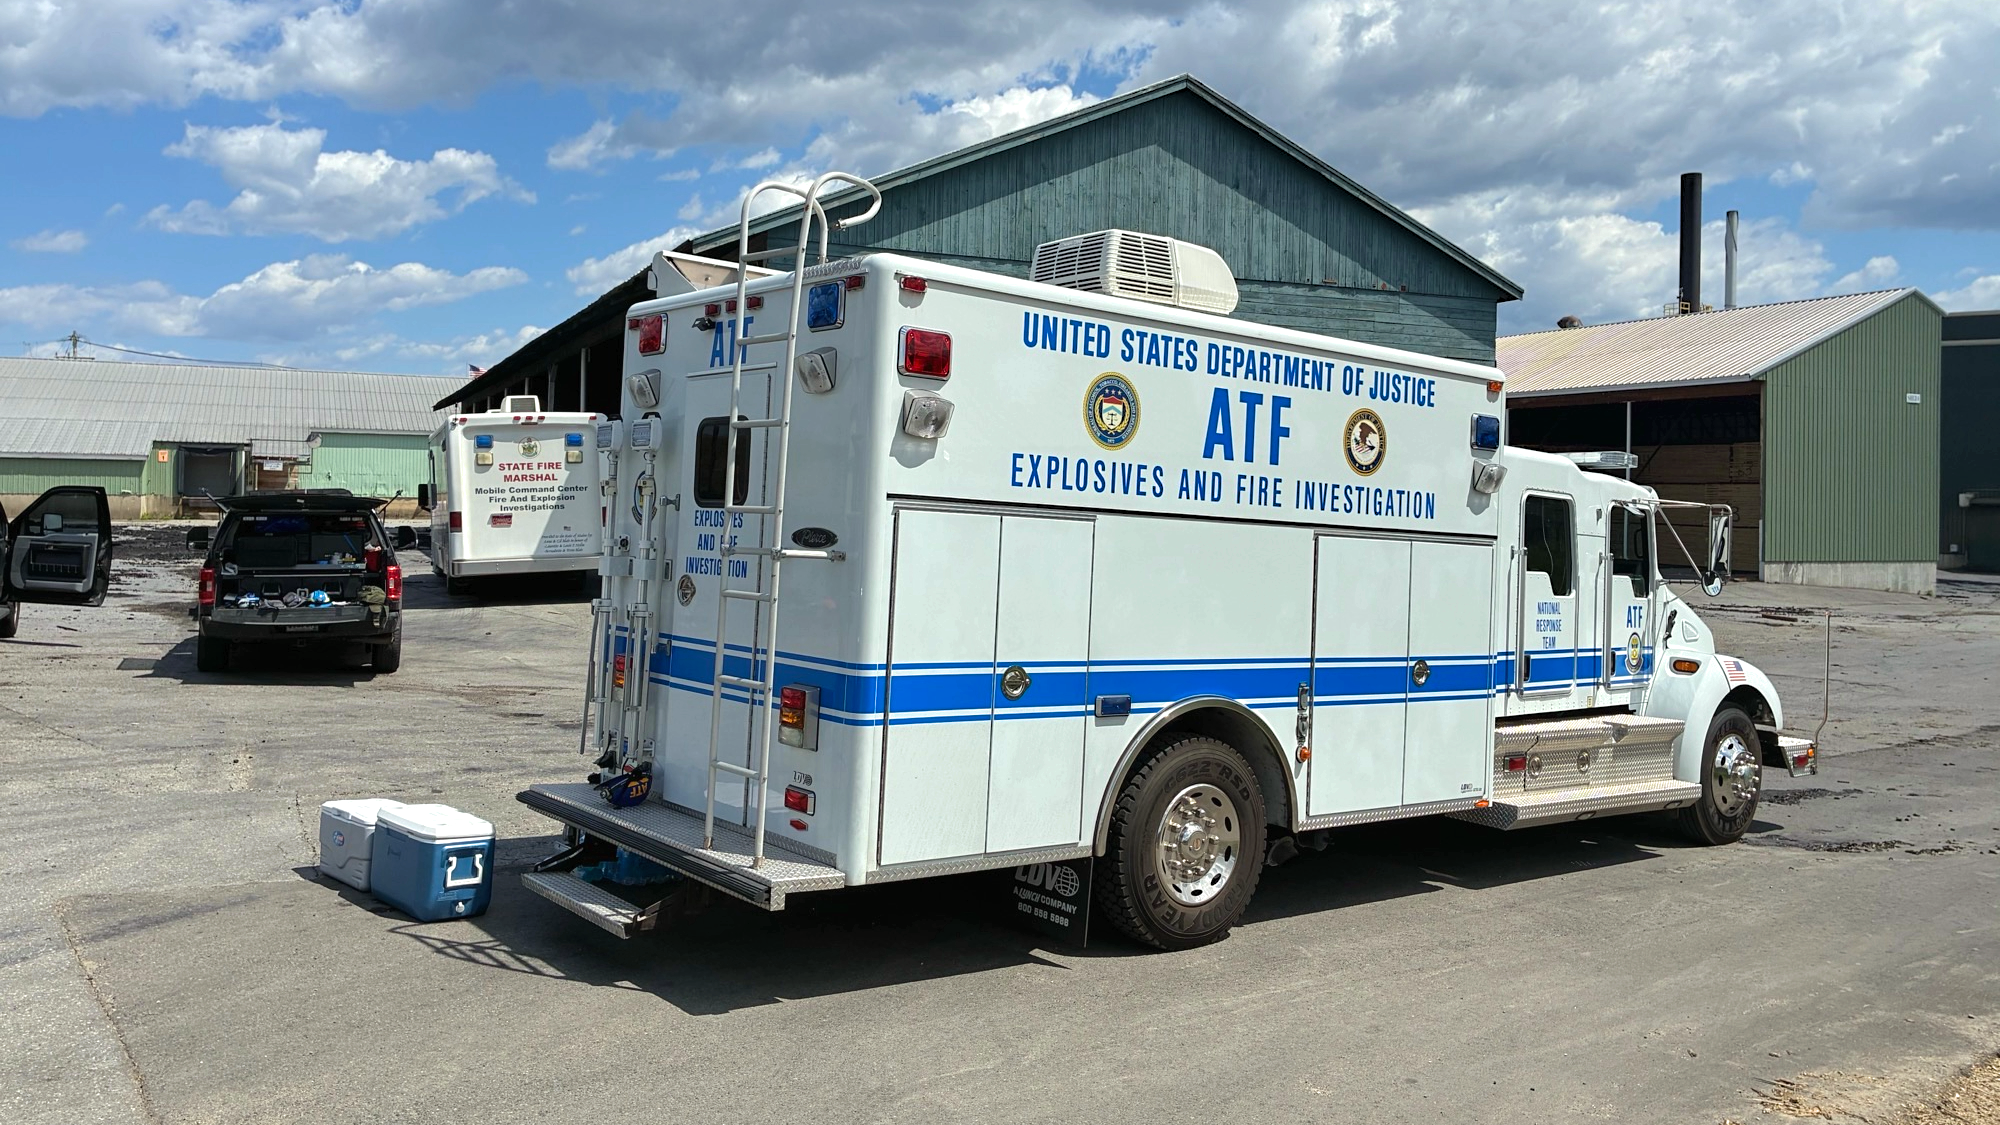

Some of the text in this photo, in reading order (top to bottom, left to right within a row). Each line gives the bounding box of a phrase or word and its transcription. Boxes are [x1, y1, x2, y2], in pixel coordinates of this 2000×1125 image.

[1023, 311, 1436, 408] UNITED STATES DEPARTMENT OF JUSTICE
[1202, 387, 1292, 466] ATF
[498, 462, 562, 471] STATE FIRE
[504, 474, 558, 482] MARSHAL
[1011, 452, 1435, 520] EXPLOSIVES AND FIRE INVESTIGATION
[508, 486, 554, 494] Command
[530, 494, 575, 502] Explosion
[500, 504, 565, 512] Investigations
[694, 510, 744, 528] EXPLOSES
[697, 533, 715, 551] AND
[685, 556, 748, 578] INVESTIGTION
[1537, 602, 1561, 614] NATIONAL
[1626, 606, 1642, 628] ATF
[1536, 619, 1562, 632] RESPONSE
[1542, 636, 1556, 649] TEAM
[1220, 764, 1250, 802] RSD
[1014, 862, 1062, 890] LDV
[1013, 886, 1018, 895] A
[1040, 895, 1078, 915] COMPANY
[1018, 902, 1032, 914] 800
